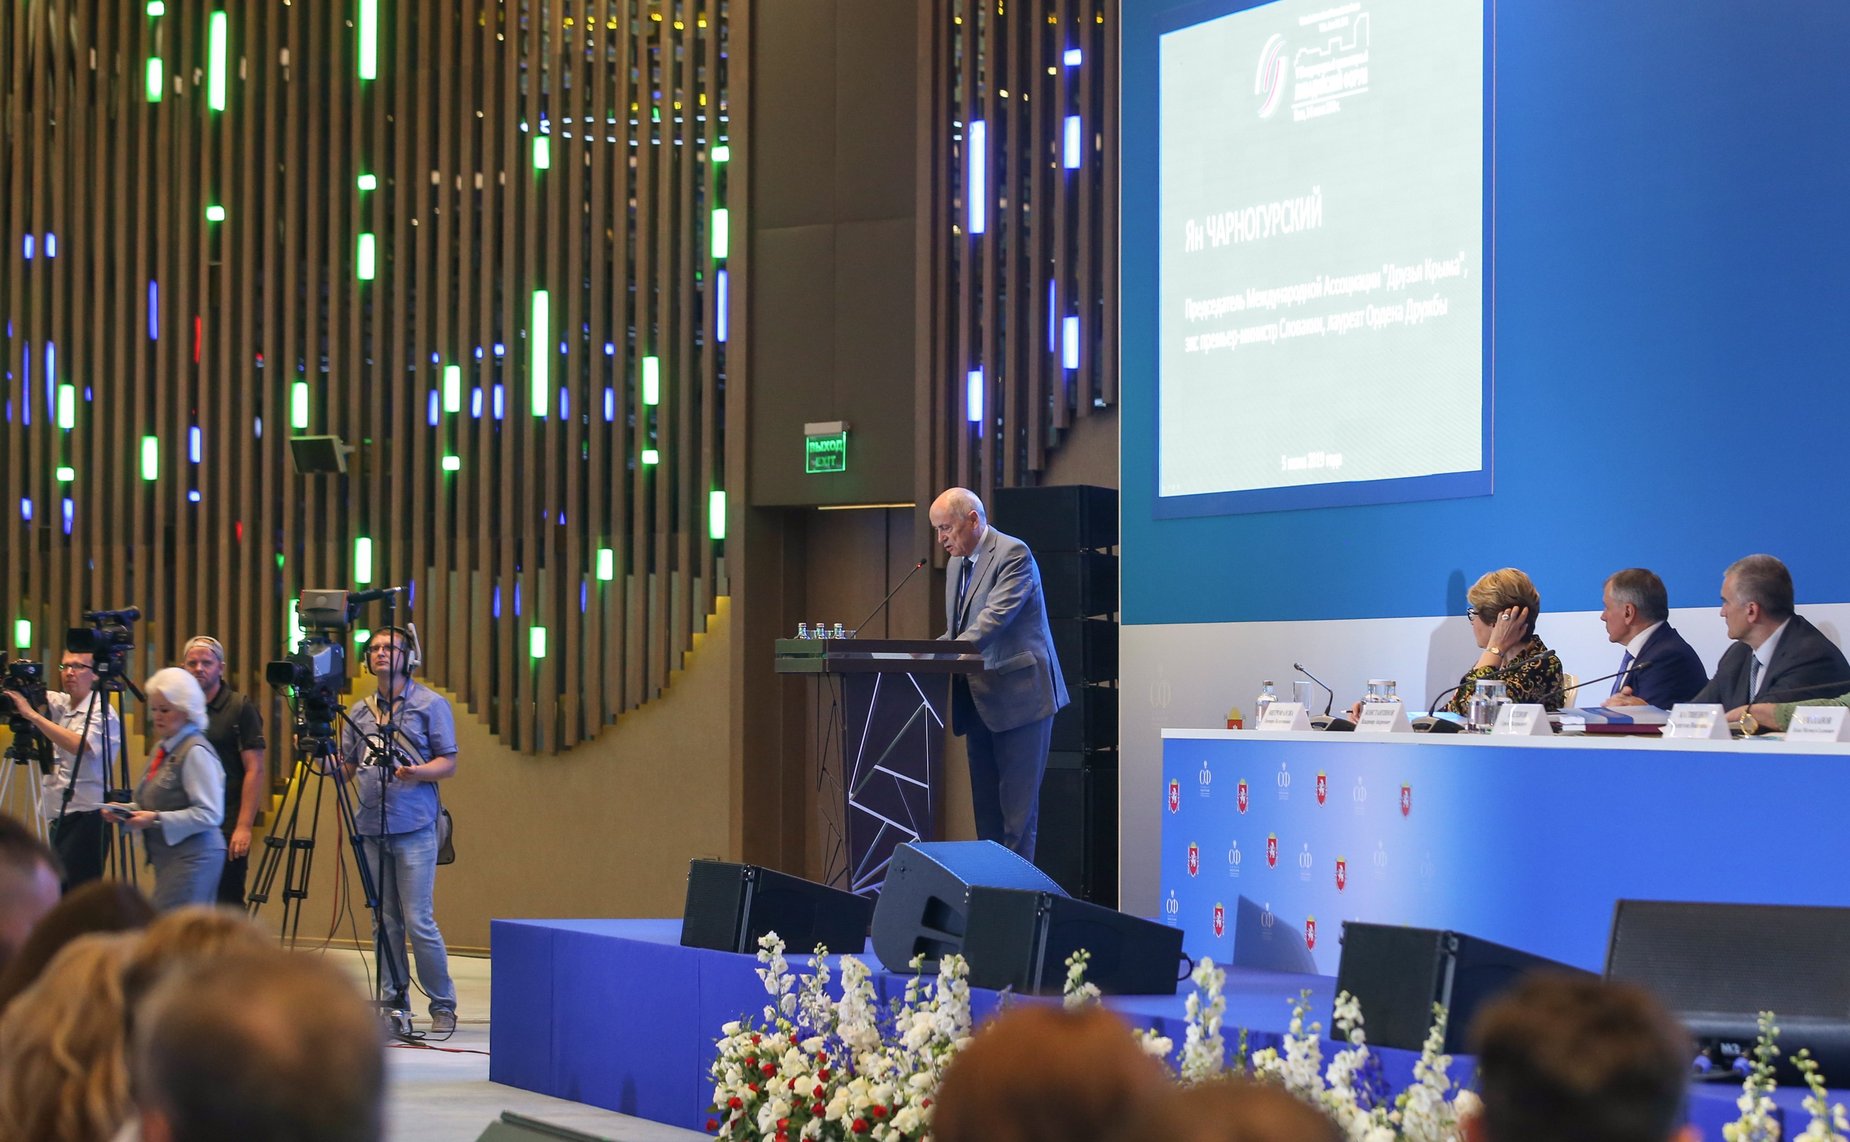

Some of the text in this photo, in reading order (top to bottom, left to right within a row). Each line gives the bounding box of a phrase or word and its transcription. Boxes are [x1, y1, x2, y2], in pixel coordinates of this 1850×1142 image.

[1185, 185, 1323, 254] Ян ЧАРНОГУРСКИЙ
[1185, 294, 1246, 322] Председатель
[1246, 275, 1322, 310] Международной
[1323, 274, 1381, 297] Ассоциации
[1382, 263, 1423, 291] "Друзья
[1326, 309, 1366, 335] лауреат
[1366, 304, 1404, 330] Ордена
[1404, 292, 1449, 326] Дружбы
[809, 440, 844, 453] ВЫХОД
[815, 455, 836, 467] EXIT
